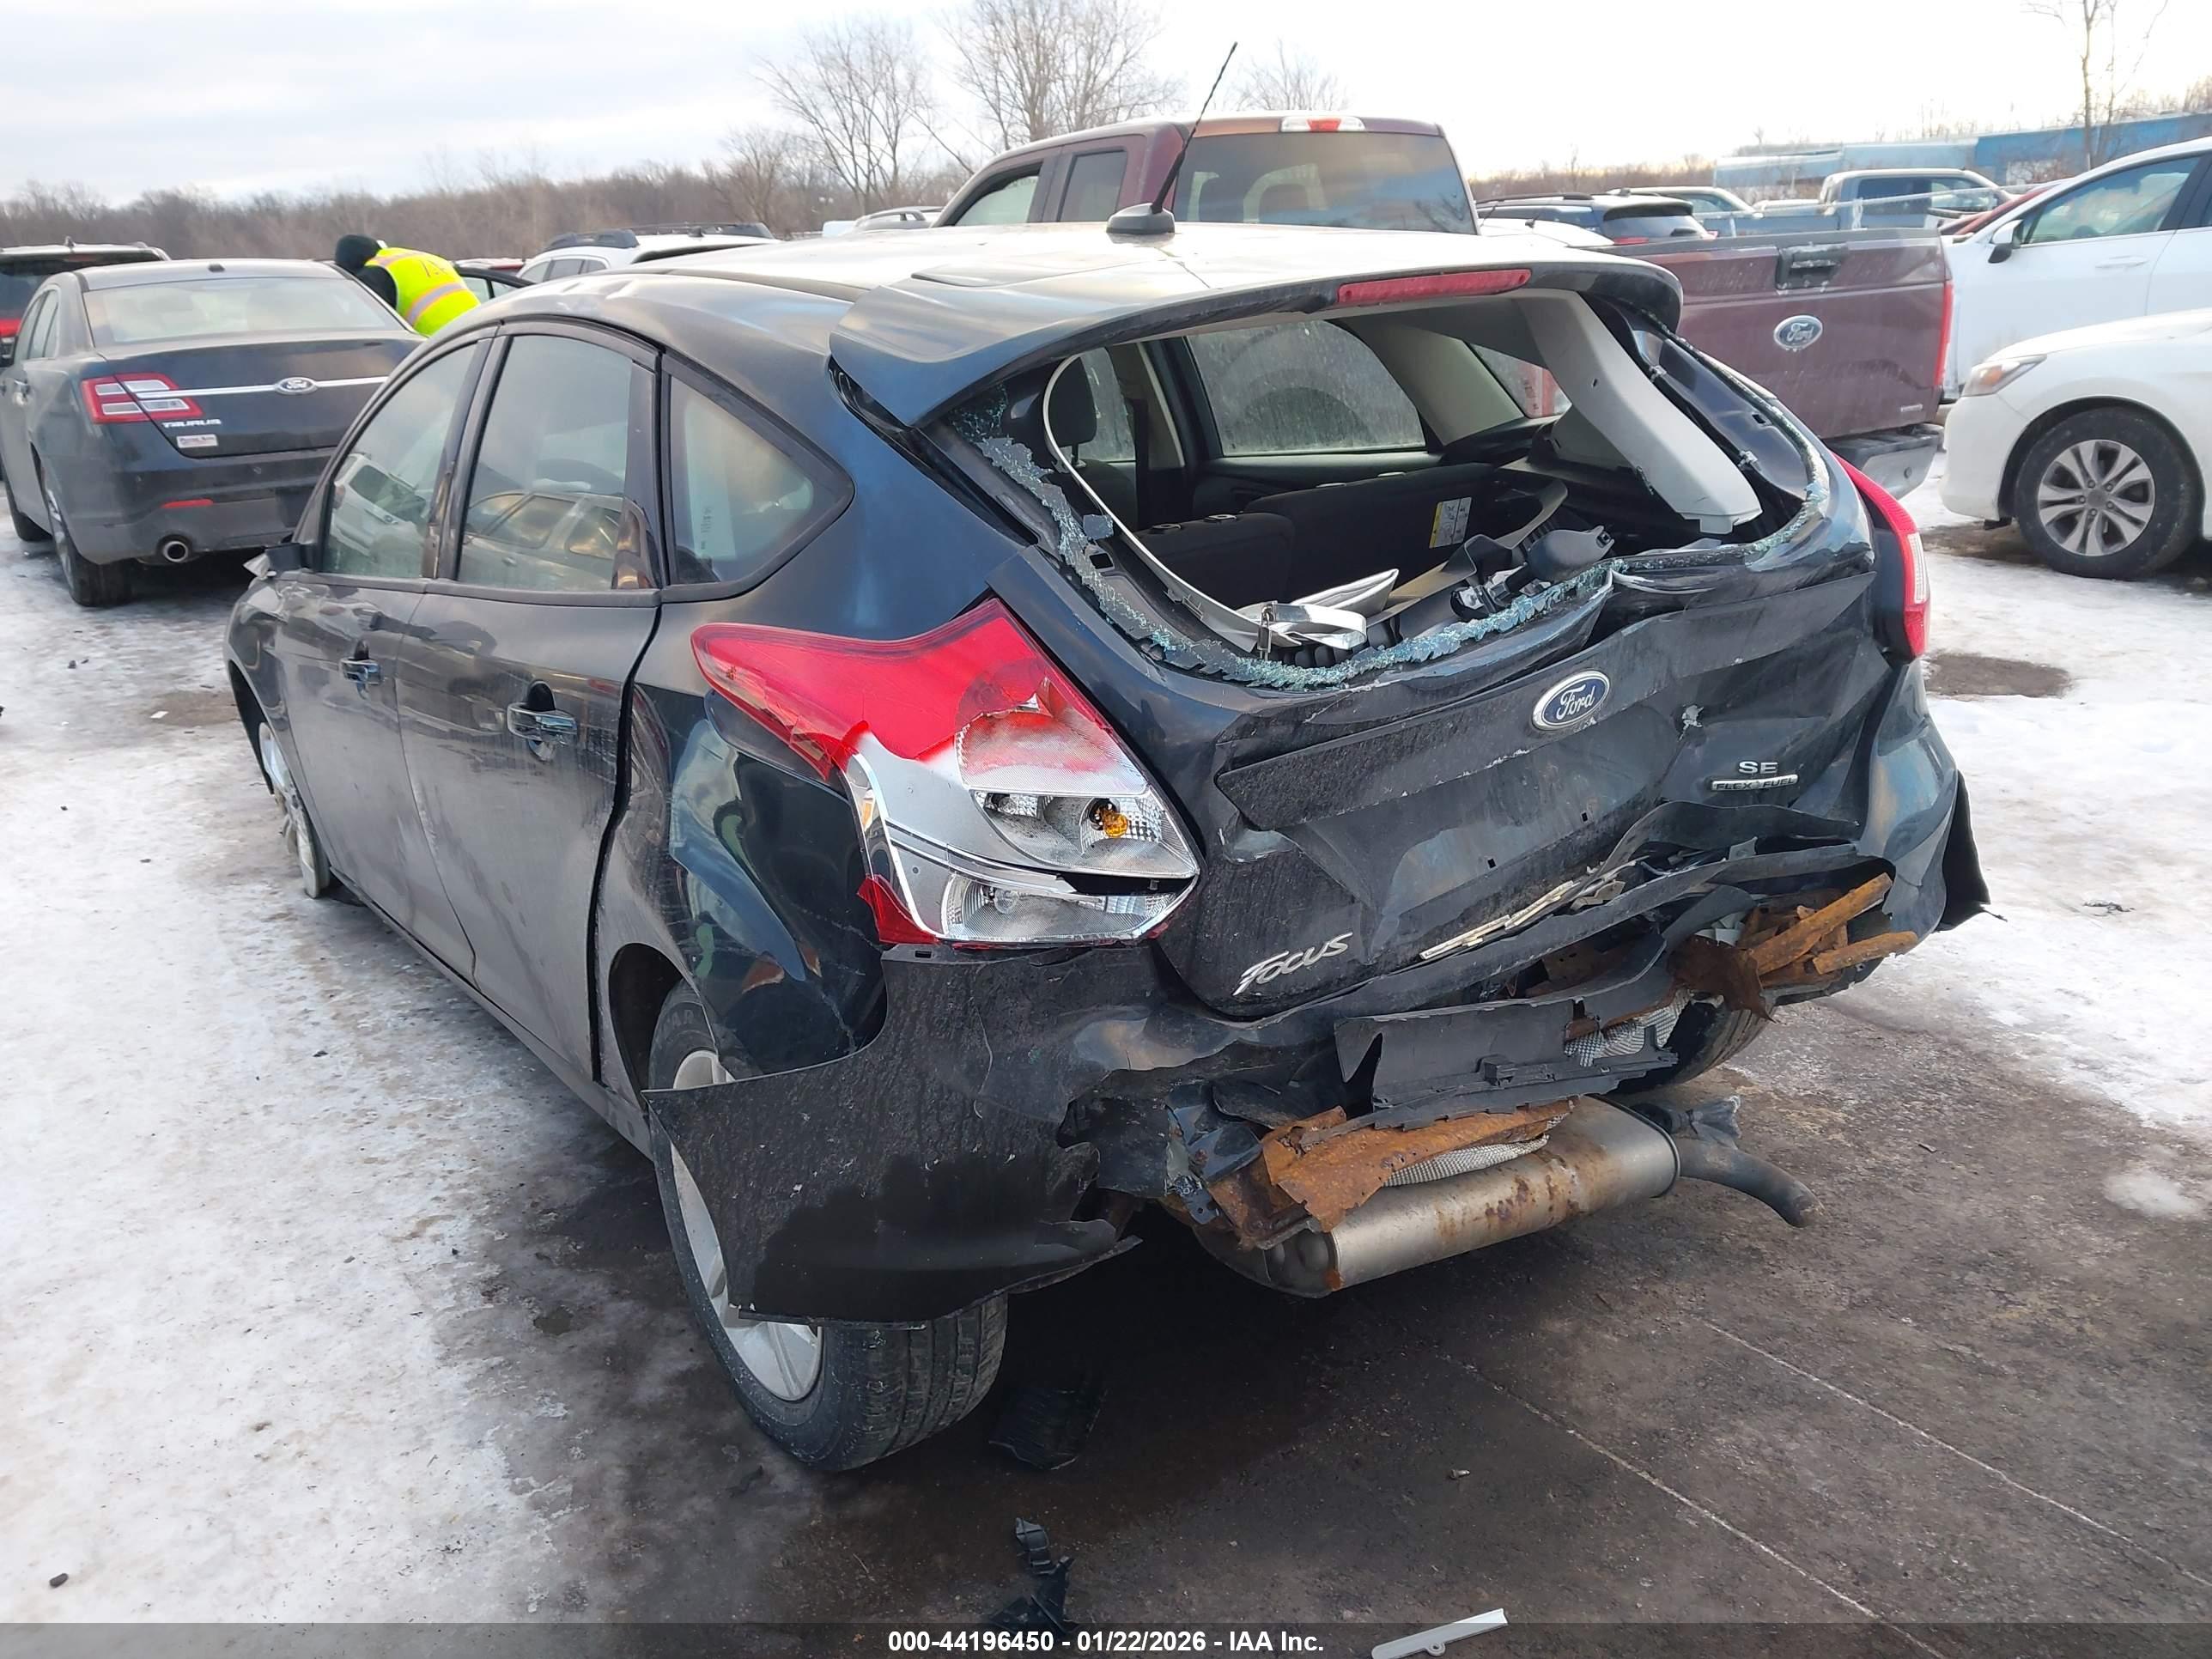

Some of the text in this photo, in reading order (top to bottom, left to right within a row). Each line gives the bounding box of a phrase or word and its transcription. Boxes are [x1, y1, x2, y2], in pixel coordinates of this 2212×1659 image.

[161, 418, 222, 428] TAURUS
[1556, 684, 1596, 720] Ford
[1738, 761, 1778, 775] SE
[1763, 778, 1795, 788] FUEL
